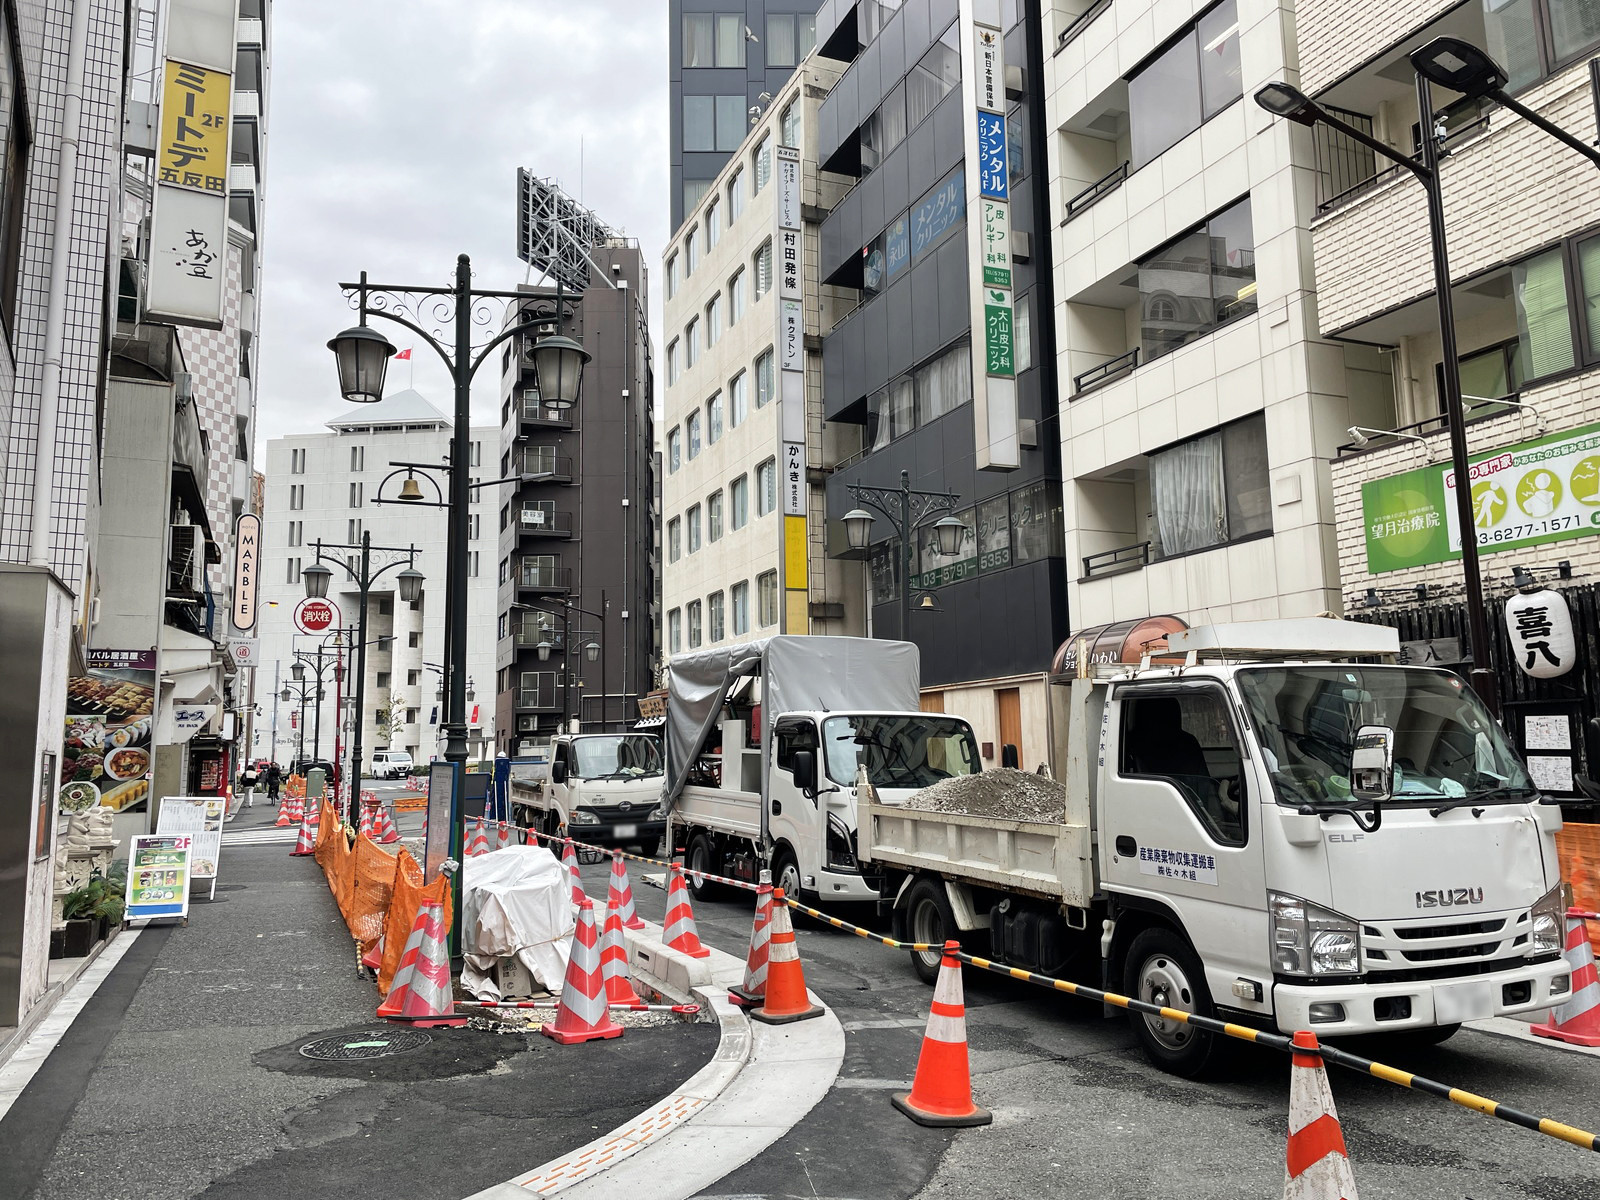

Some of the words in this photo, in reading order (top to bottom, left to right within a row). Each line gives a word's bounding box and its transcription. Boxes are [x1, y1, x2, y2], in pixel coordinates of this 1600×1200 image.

[166, 64, 209, 168] ミートデ
[201, 113, 225, 128] 2F
[979, 117, 989, 161] クリニック
[988, 120, 1005, 192] メンタル
[160, 166, 225, 192] 五反田
[982, 169, 989, 190] 4F
[916, 183, 958, 233] メンタル
[985, 203, 996, 264] アレルギー科
[996, 209, 1007, 264] 皮フ科
[988, 315, 1000, 371] クリニック
[998, 310, 1011, 368] 大山皮フ科
[788, 445, 800, 482] かんき
[1371, 511, 1441, 540] 望月治療院
[1475, 515, 1580, 544] 3-6277-1571
[240, 535, 254, 615] MARBLE
[304, 610, 330, 622] 消火栓
[1513, 606, 1561, 670] 喜八
[174, 837, 192, 849] 2F
[1328, 833, 1365, 843] ELF
[1140, 847, 1215, 871] 産業廃棄物収集運搬車
[1415, 886, 1484, 909] ISUZU
